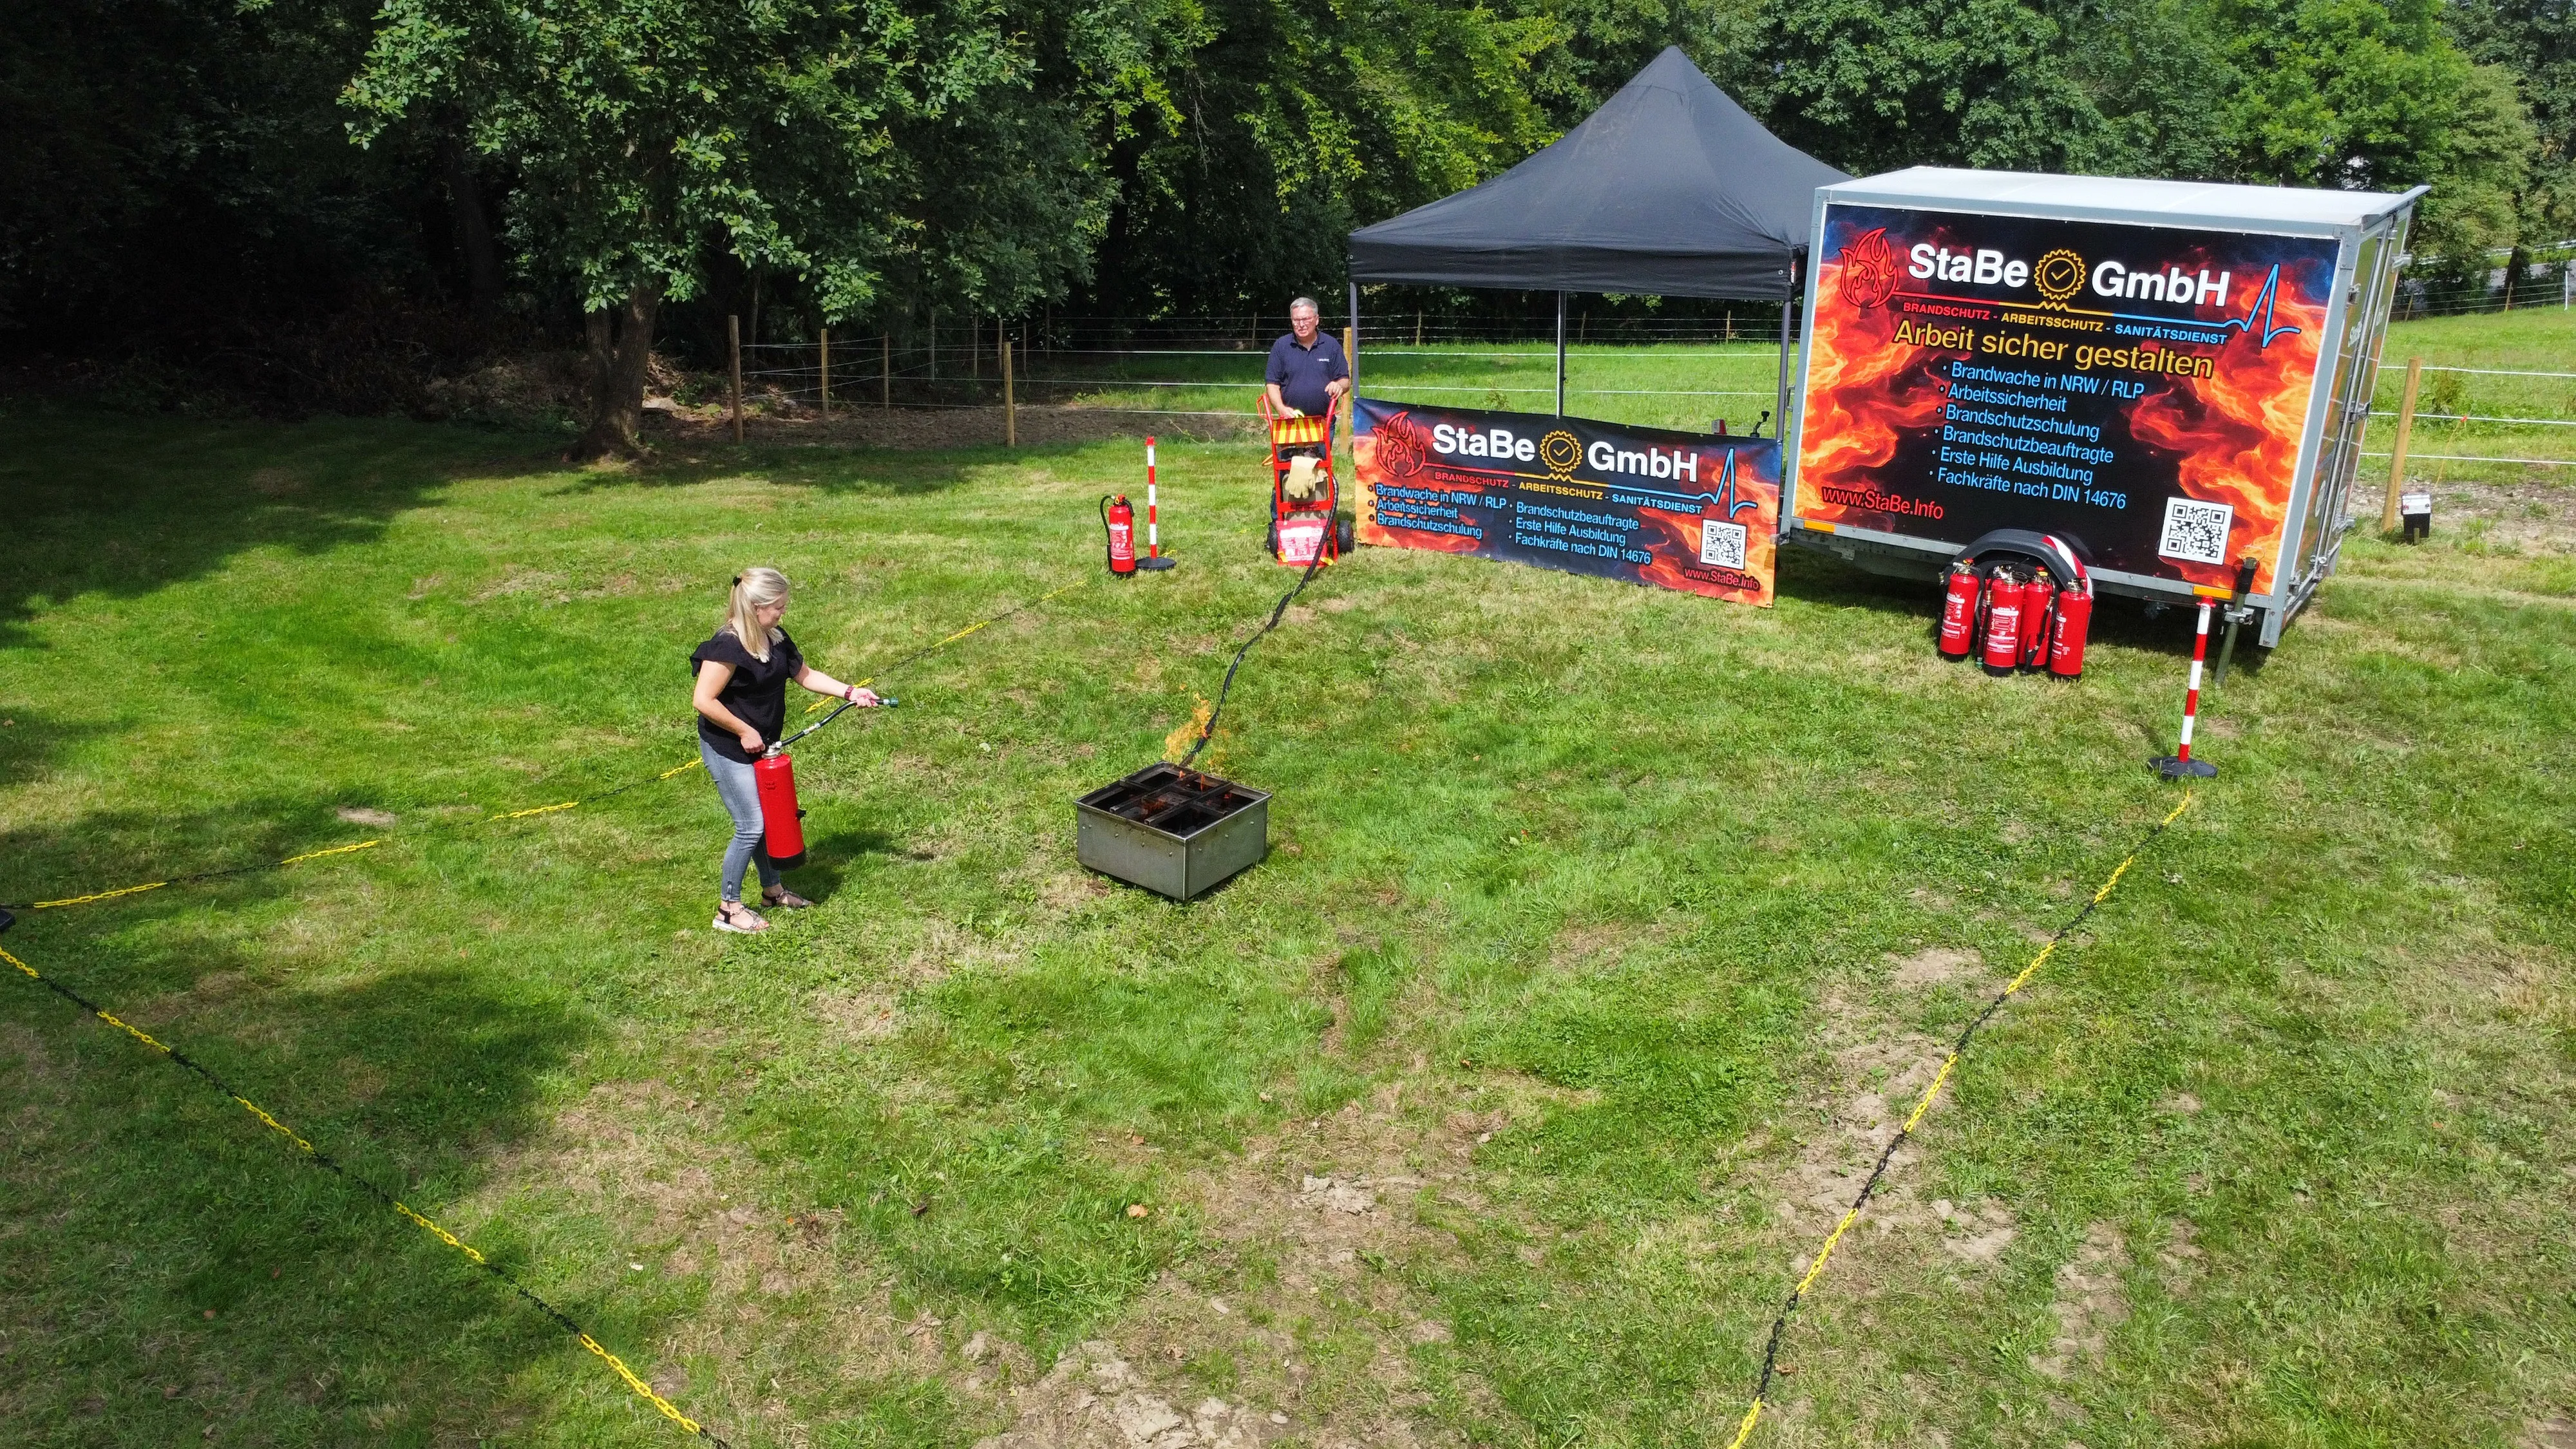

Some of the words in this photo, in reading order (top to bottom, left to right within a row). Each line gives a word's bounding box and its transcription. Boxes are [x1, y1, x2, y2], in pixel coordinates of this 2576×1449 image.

[1908, 243, 2028, 287] StaBe
[2092, 261, 2230, 307] GmbH
[1903, 302, 1990, 320] BRANDSCHUTZ
[2001, 313, 2104, 332] ARBEITSSCHUTZ
[2114, 324, 2228, 345] SANITÄTSDIENST
[1894, 320, 1975, 350] Arbeit
[1981, 330, 2069, 361] sicher
[2074, 343, 2213, 378] gestalten
[1947, 383, 2067, 412] Arbeitssicherheit
[1951, 361, 2041, 387] Brandwache
[2043, 372, 2056, 390] in
[2060, 374, 2099, 393] NRW
[2101, 379, 2109, 395] /
[2111, 380, 2145, 399] RLP
[1946, 404, 2100, 442] Brandschutzschulung
[1432, 423, 1536, 462] StaBe
[1587, 441, 1698, 482] GmbH
[1943, 425, 2114, 465] Brandschutzbeauftragte
[1940, 446, 1976, 466] Erste
[1978, 451, 2010, 471] Hilfe
[2012, 457, 2094, 486] Ausbildung
[1376, 484, 1439, 502] Brandwache
[1440, 491, 1449, 503] in
[1451, 492, 1477, 506] NRW
[1485, 496, 1507, 509] RLP
[1434, 471, 1510, 488] BRANDSCHUTZ
[1519, 482, 1603, 500] ARBEITSSCHUTZ
[1611, 493, 1703, 515] SANITÄTSDIENST
[1823, 488, 1944, 520] www.StaBe.Info
[1937, 466, 2011, 493] Fachkräfte
[2013, 481, 2049, 498] nach
[2052, 484, 2080, 502] DIN
[2083, 489, 2126, 509] 14676
[1377, 498, 1458, 519] Arbeitssicherheit
[1378, 513, 1482, 539] Brandschutzschulung
[1517, 501, 1639, 531] Brandschutzbeauftragte
[1515, 517, 1542, 532] Erste
[1544, 520, 1567, 535] Hilfe
[1569, 524, 1626, 547] Ausbildung
[1515, 532, 1569, 551] Fachkräfte
[1571, 544, 1596, 556] nach
[1598, 545, 1618, 560] DIN
[1620, 549, 1652, 565] 14676
[1685, 567, 1759, 590] www.StaBe.Info
